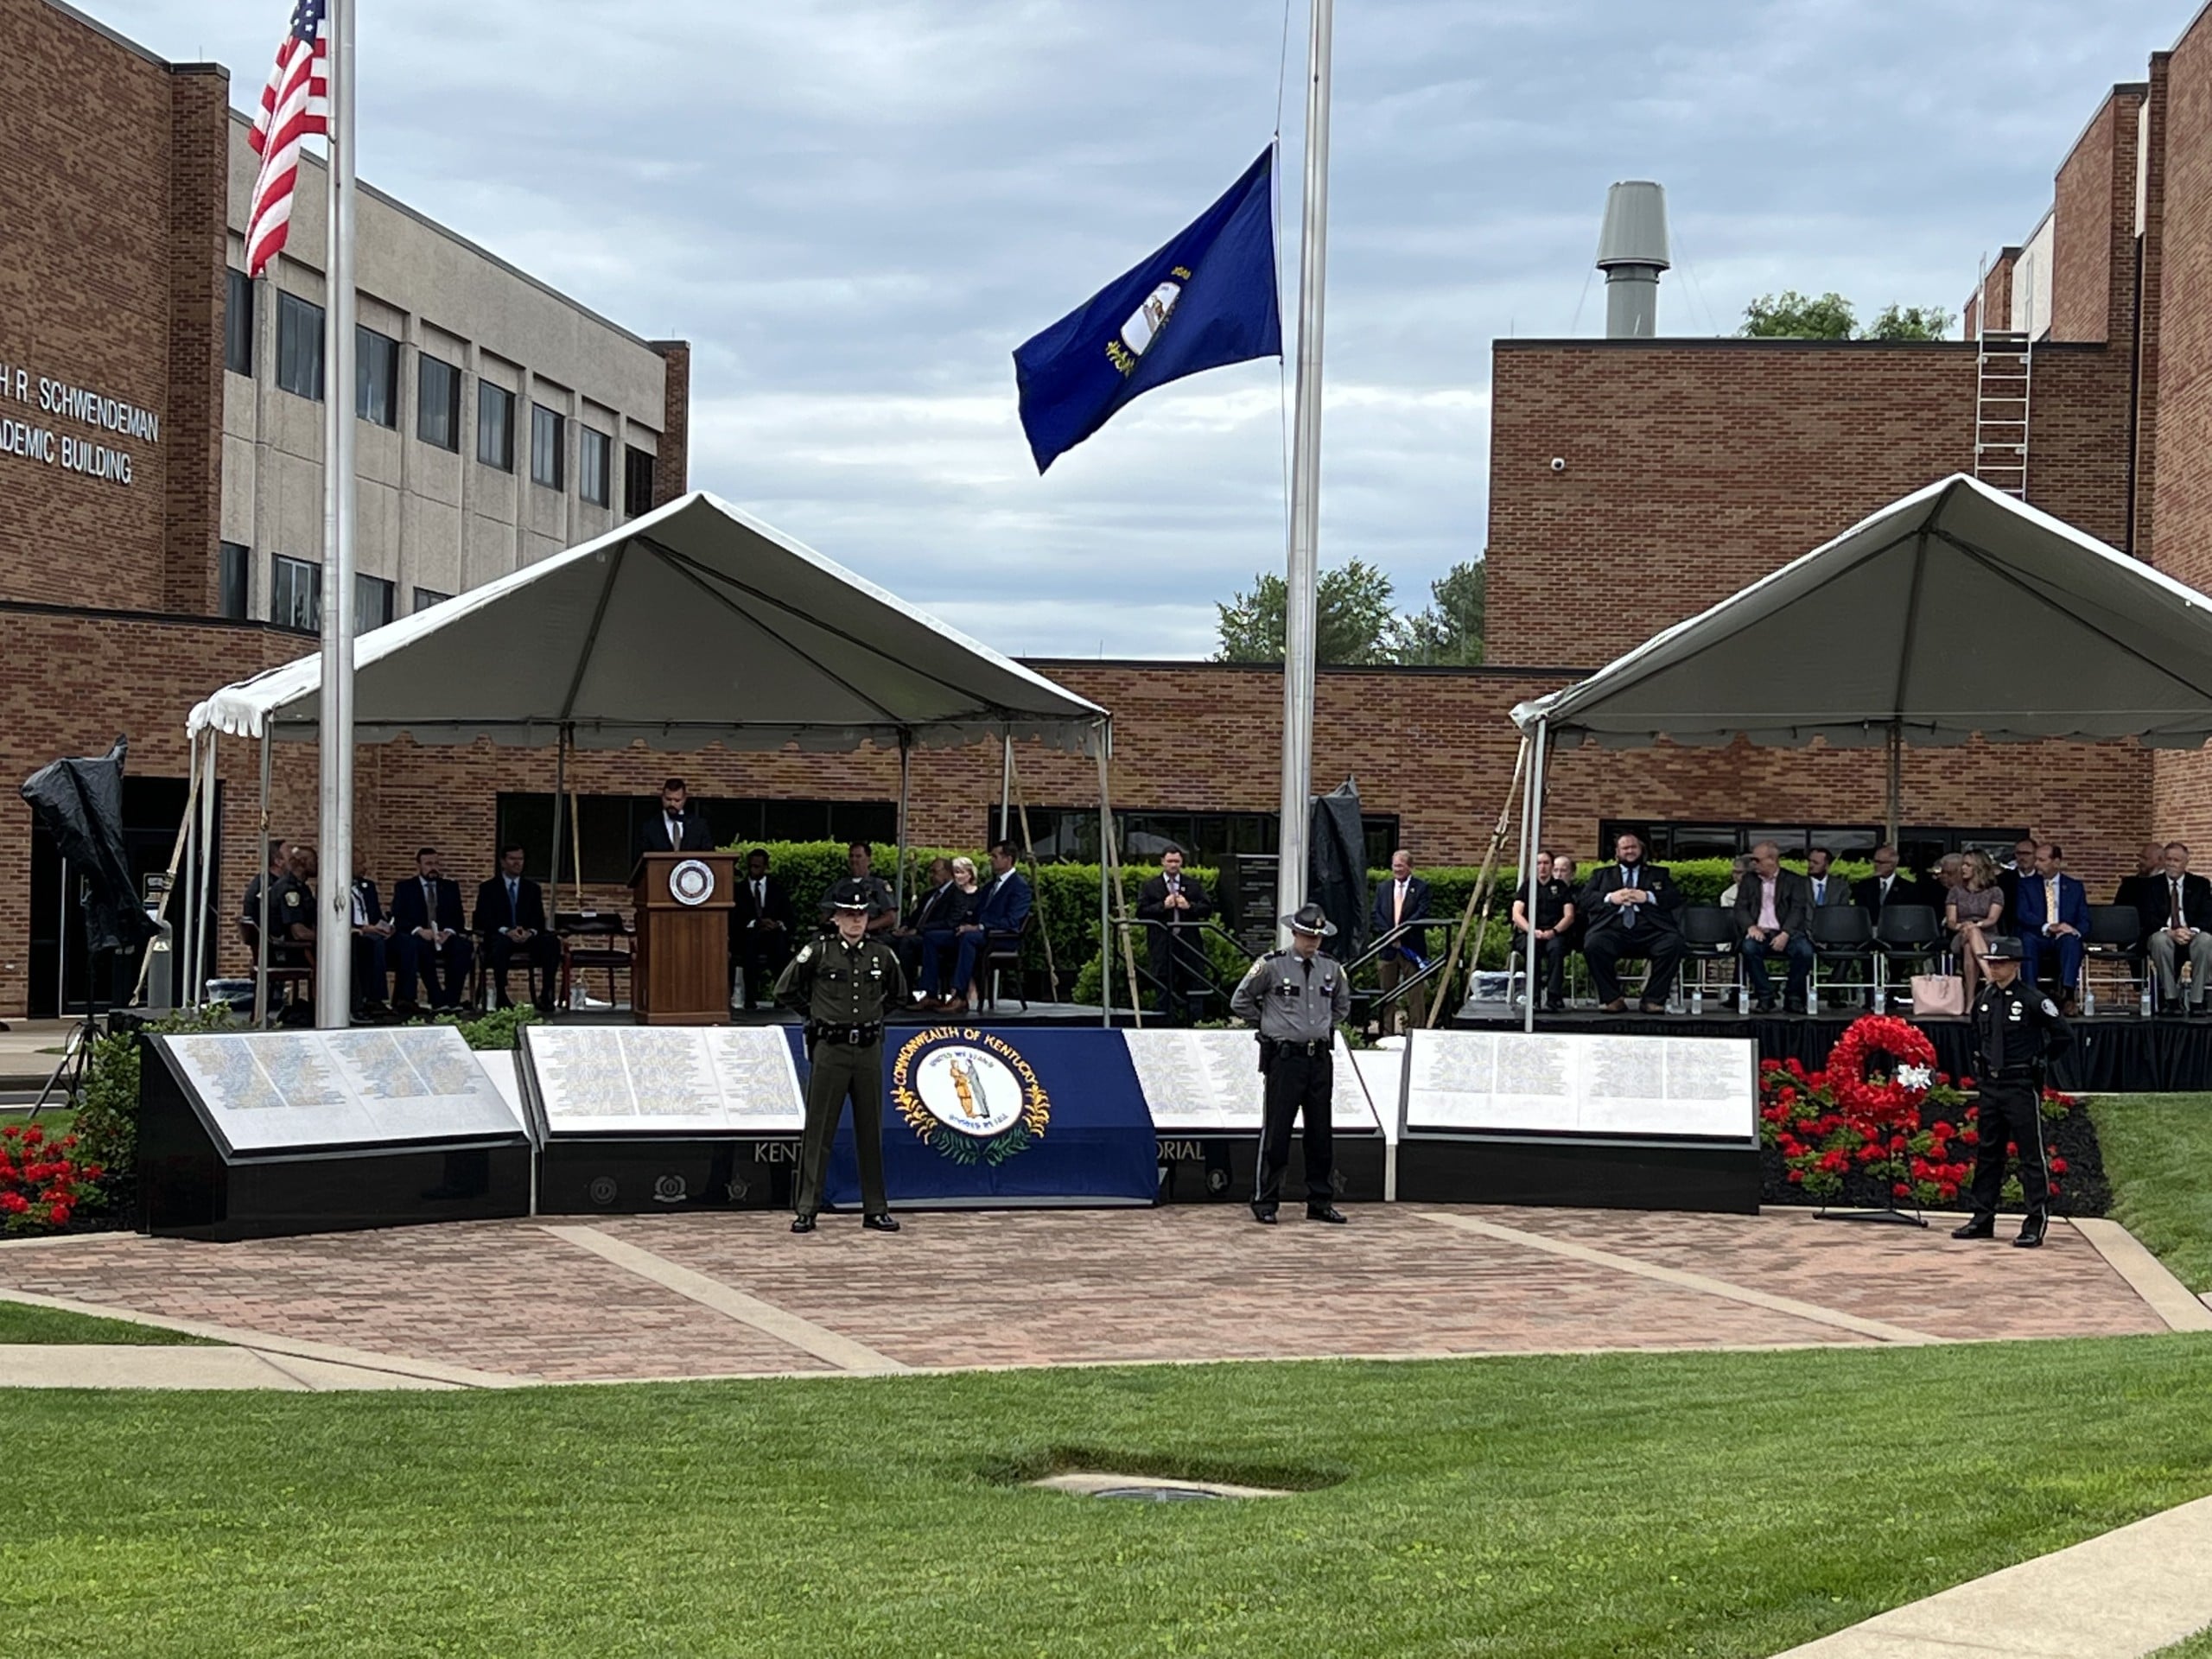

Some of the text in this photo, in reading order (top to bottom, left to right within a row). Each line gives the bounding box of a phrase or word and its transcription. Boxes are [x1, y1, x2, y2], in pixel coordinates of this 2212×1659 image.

[39, 377, 159, 443] SCHWENDEMAN
[60, 435, 132, 485] BUILDING
[963, 1028, 982, 1041] OF
